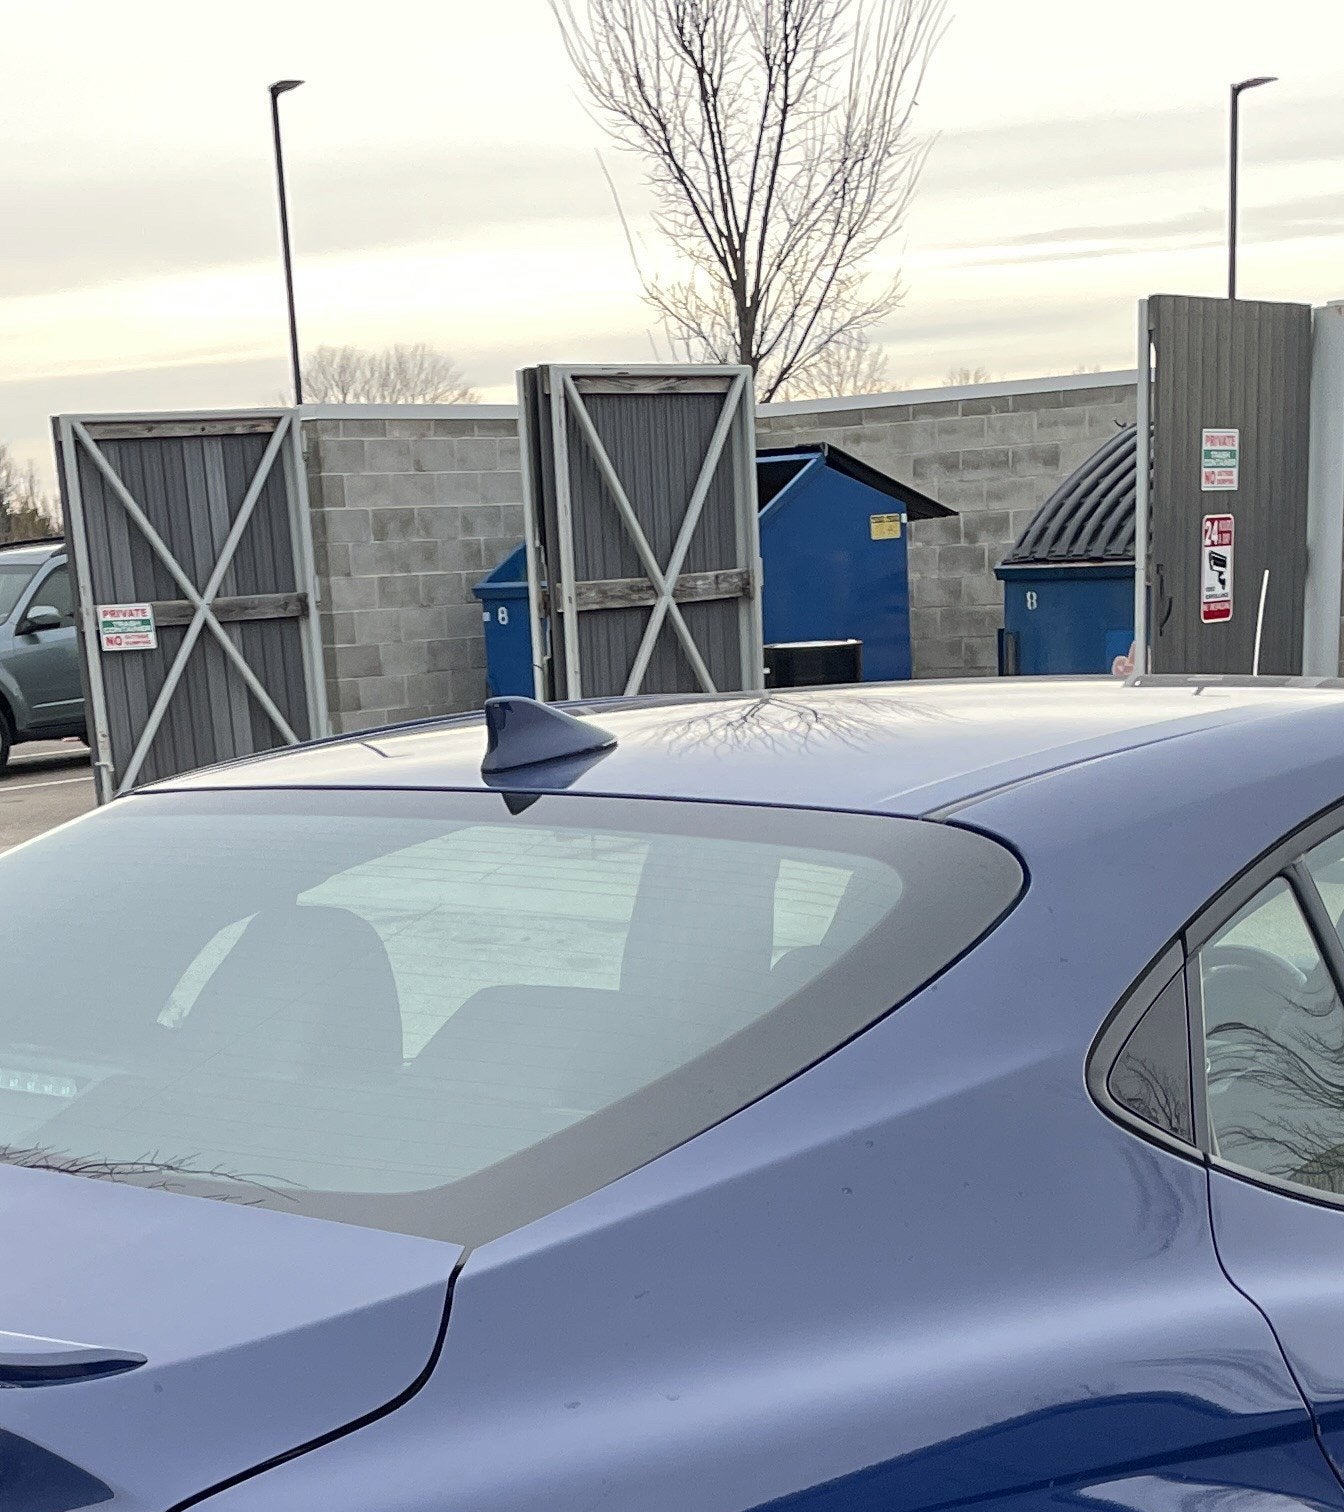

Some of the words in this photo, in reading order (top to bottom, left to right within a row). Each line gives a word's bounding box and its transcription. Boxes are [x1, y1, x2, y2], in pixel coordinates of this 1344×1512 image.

[1204, 520, 1219, 546] 24
[1026, 591, 1038, 611] 8
[102, 608, 148, 618] PRIVATE
[498, 606, 509, 625] 8
